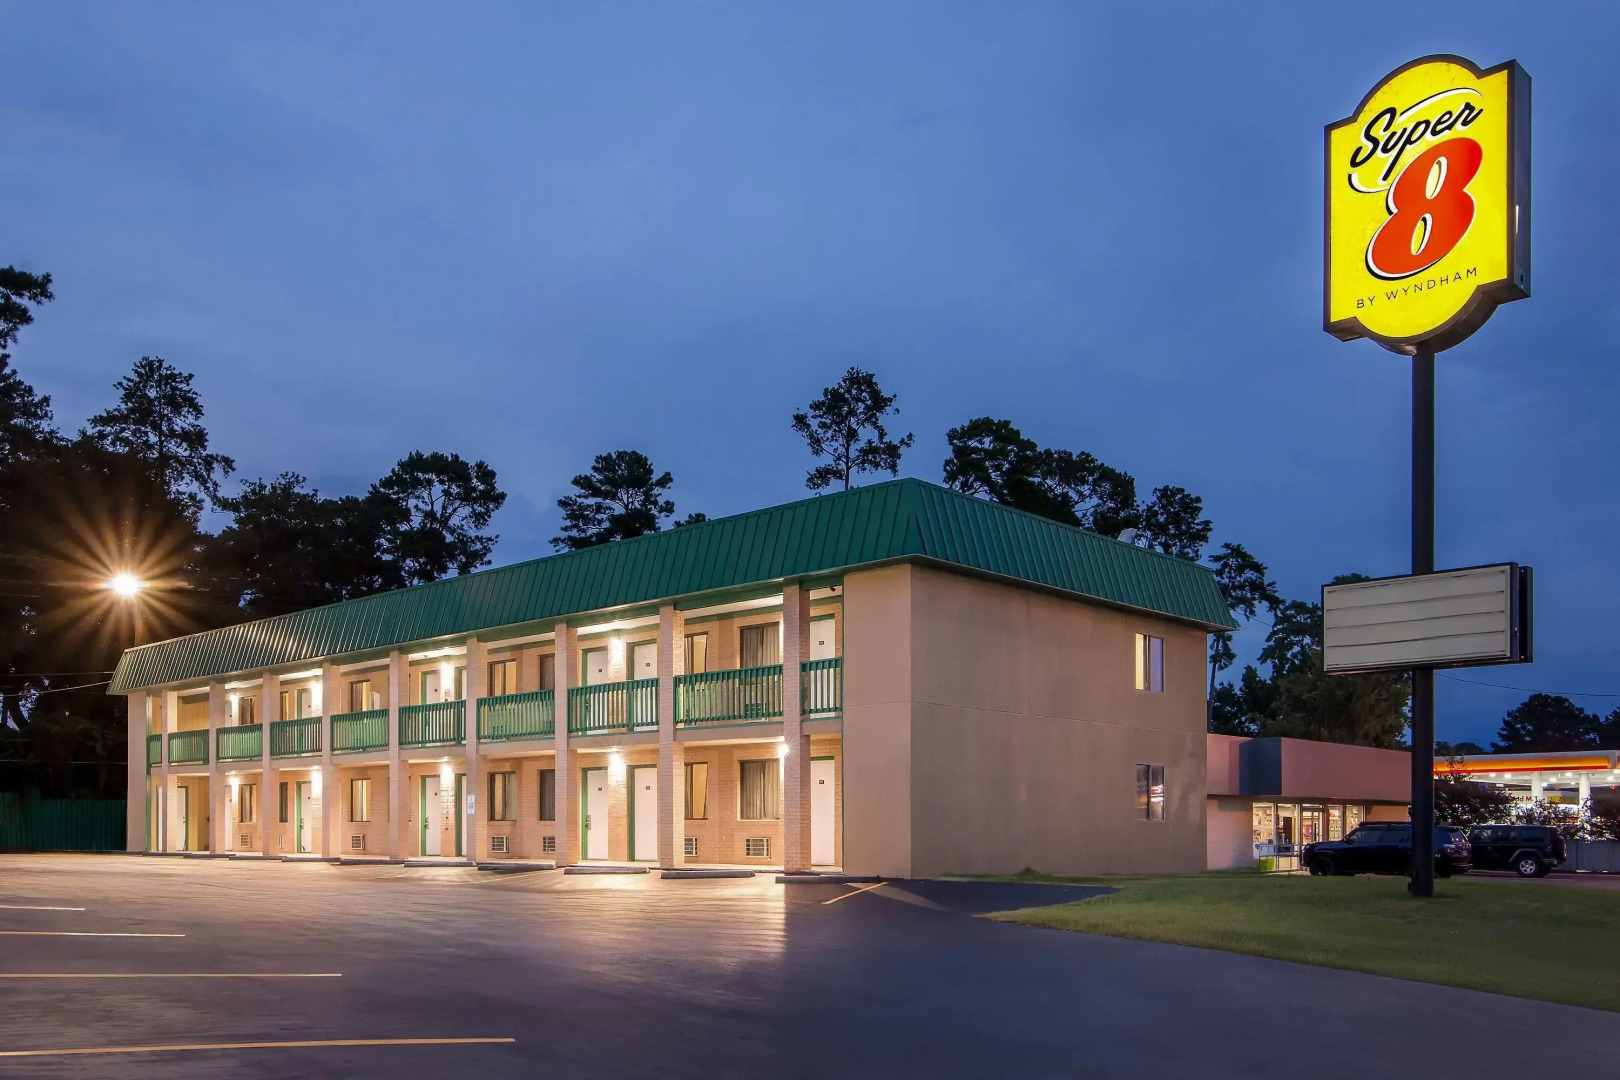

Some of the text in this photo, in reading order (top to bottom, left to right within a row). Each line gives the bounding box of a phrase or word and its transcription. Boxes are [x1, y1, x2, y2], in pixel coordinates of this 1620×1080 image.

[1350, 102, 1483, 182] Super
[1366, 137, 1483, 281] 8
[1356, 267, 1477, 309] BY WYNDHAM
